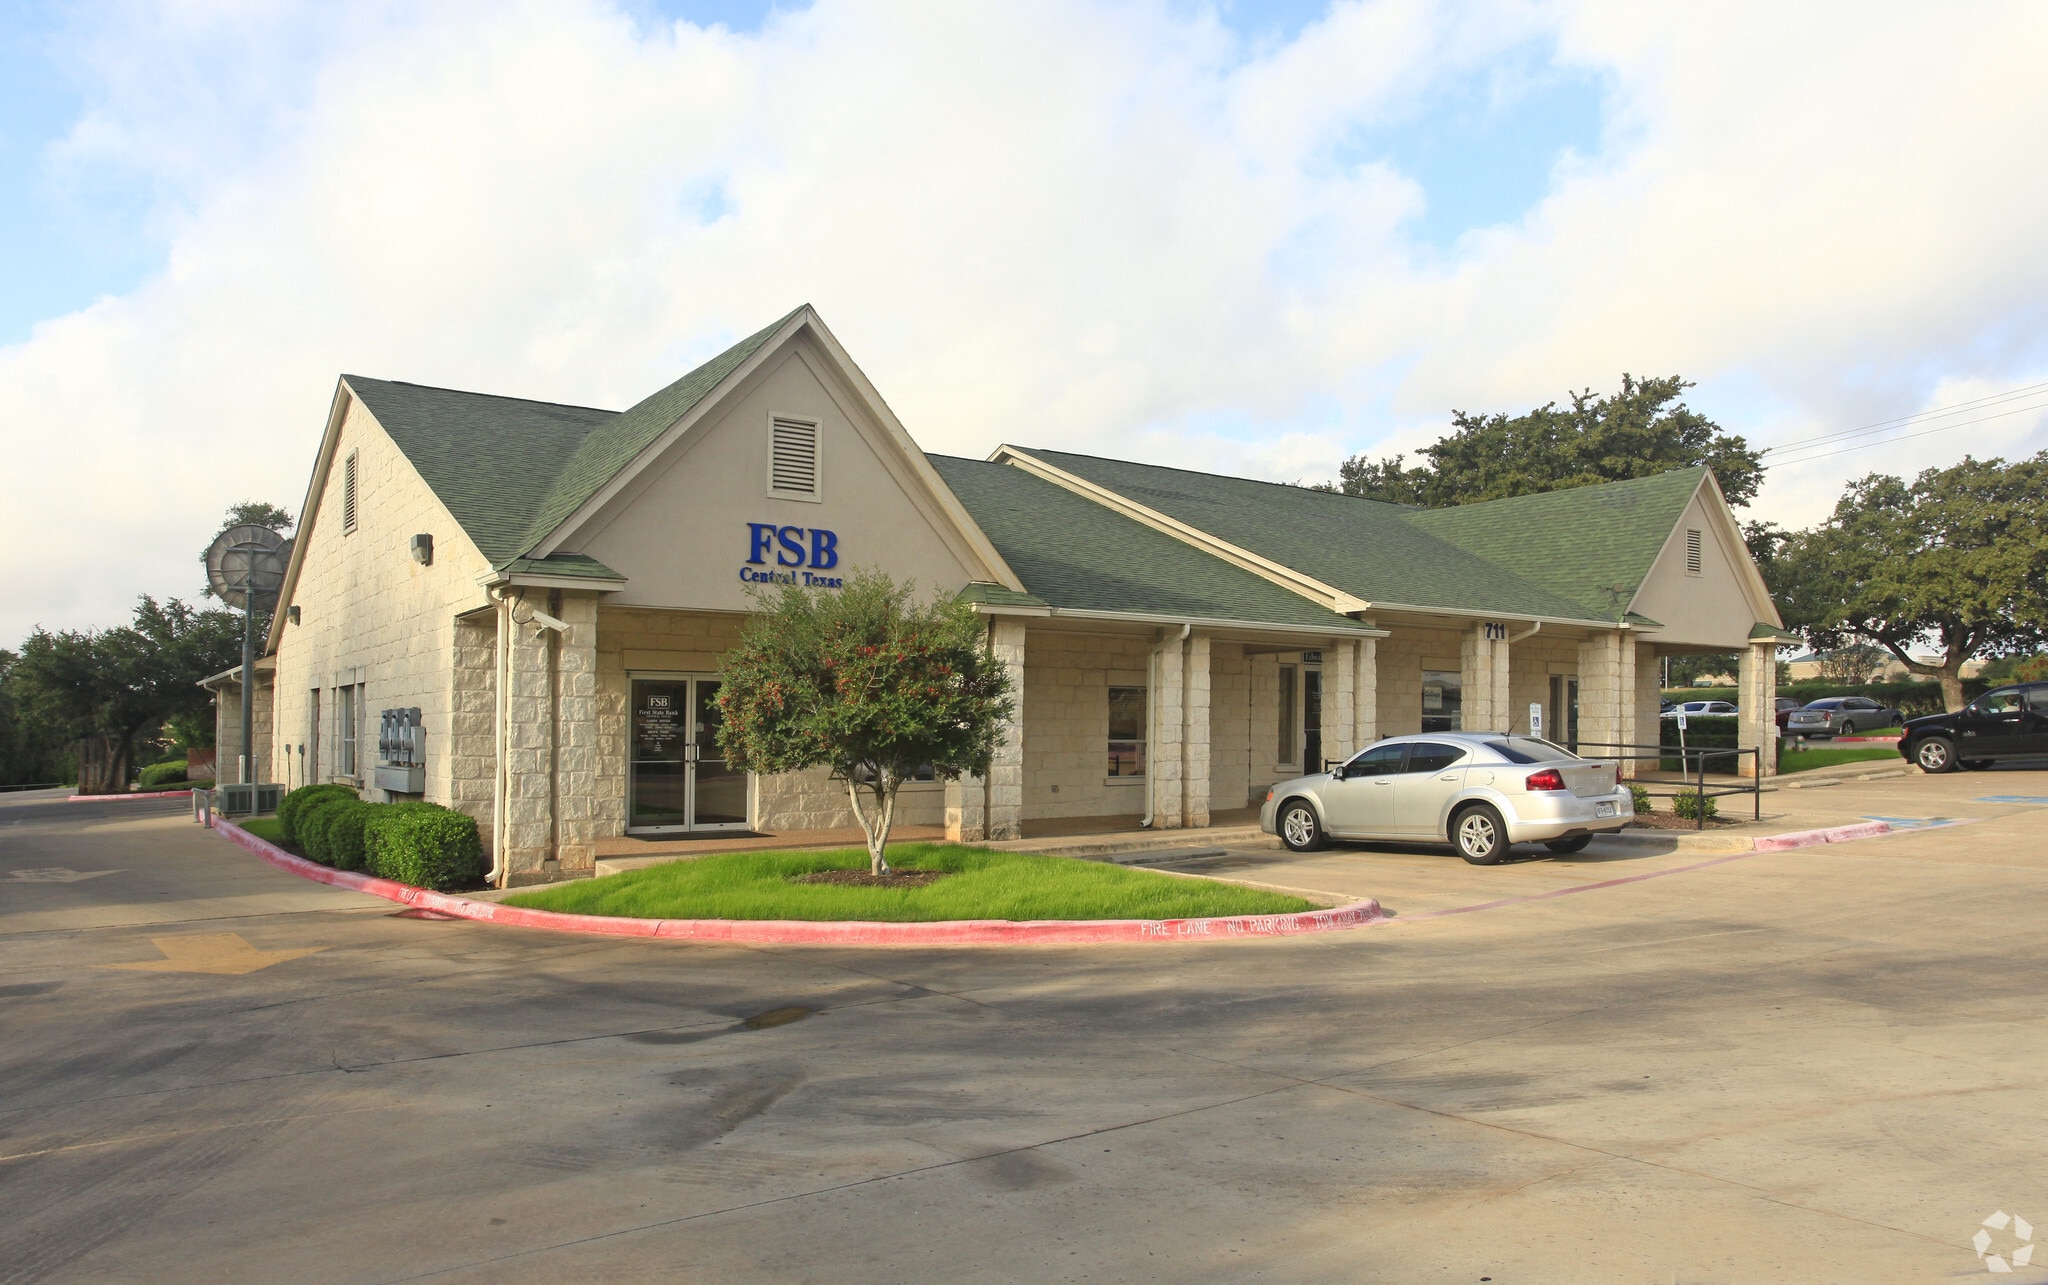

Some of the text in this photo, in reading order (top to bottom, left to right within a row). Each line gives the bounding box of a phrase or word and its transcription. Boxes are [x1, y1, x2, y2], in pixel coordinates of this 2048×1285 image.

[746, 523, 838, 569] FSB
[740, 567, 843, 588] Central Texas
[1485, 623, 1505, 639] 711
[650, 697, 668, 706] FSB
[1141, 922, 1170, 936] FIRE
[1177, 921, 1211, 935] LANE
[1227, 919, 1244, 934] NO
[1249, 916, 1299, 933] PARKING
